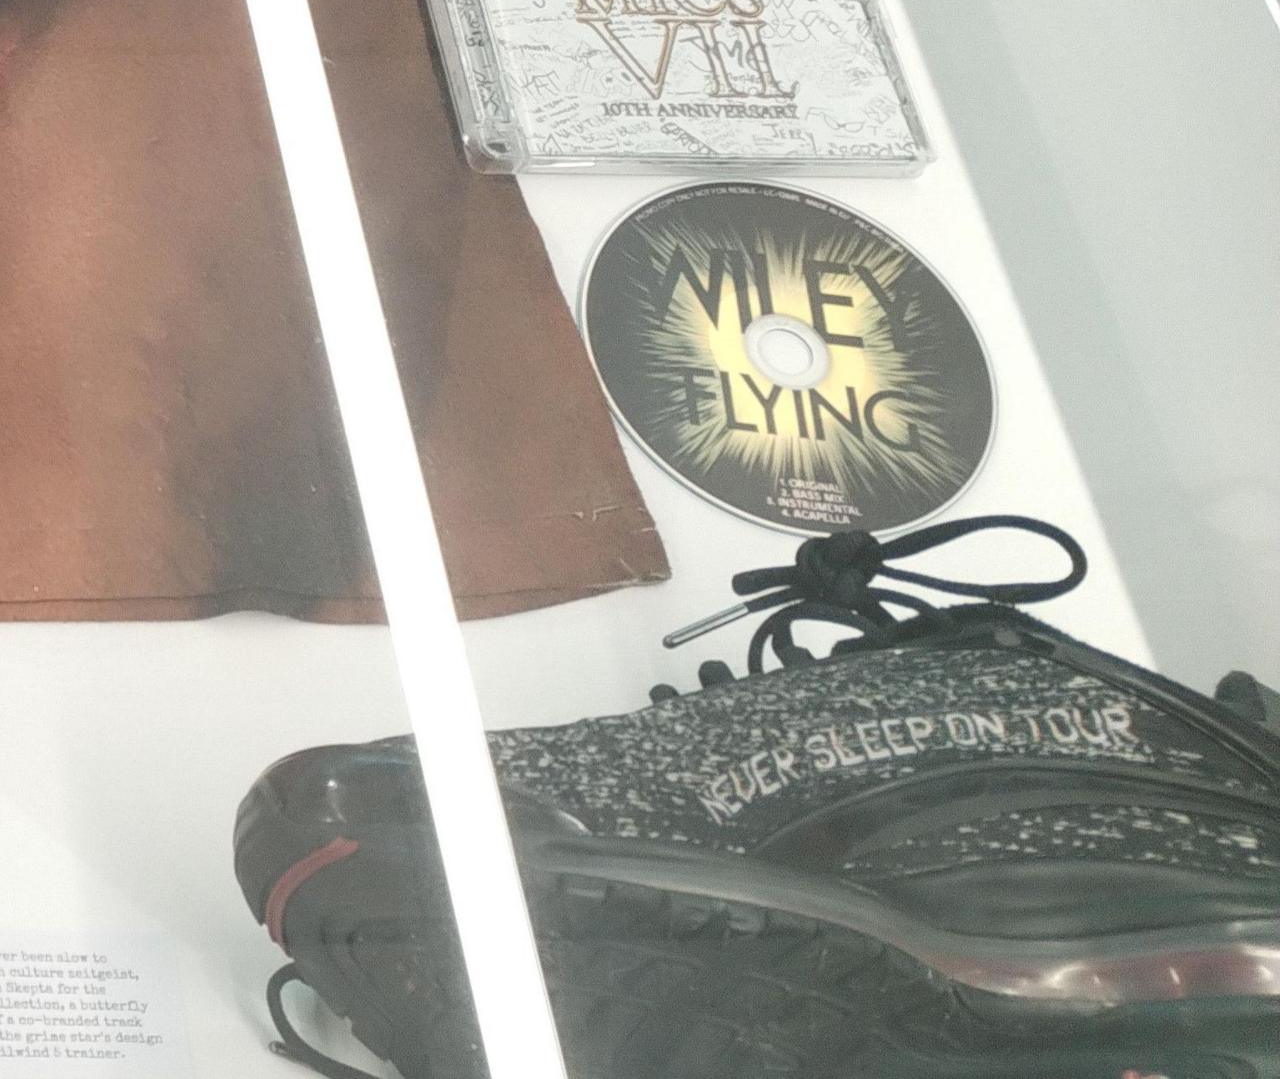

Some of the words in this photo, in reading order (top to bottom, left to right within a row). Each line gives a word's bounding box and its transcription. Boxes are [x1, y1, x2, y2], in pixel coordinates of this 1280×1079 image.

[602, 102, 650, 117] 10TH
[656, 103, 801, 120] ANNIVERSARY
[684, 367, 928, 453] FLYING
[788, 478, 840, 493] ORIGINAL
[777, 497, 864, 518] INSTRUMENTAL
[792, 509, 852, 525] ACAPELLA
[699, 746, 801, 826] NEVER
[805, 716, 936, 772] SLEEP
[944, 712, 1007, 746] ON
[1018, 706, 1142, 747] TOUR
